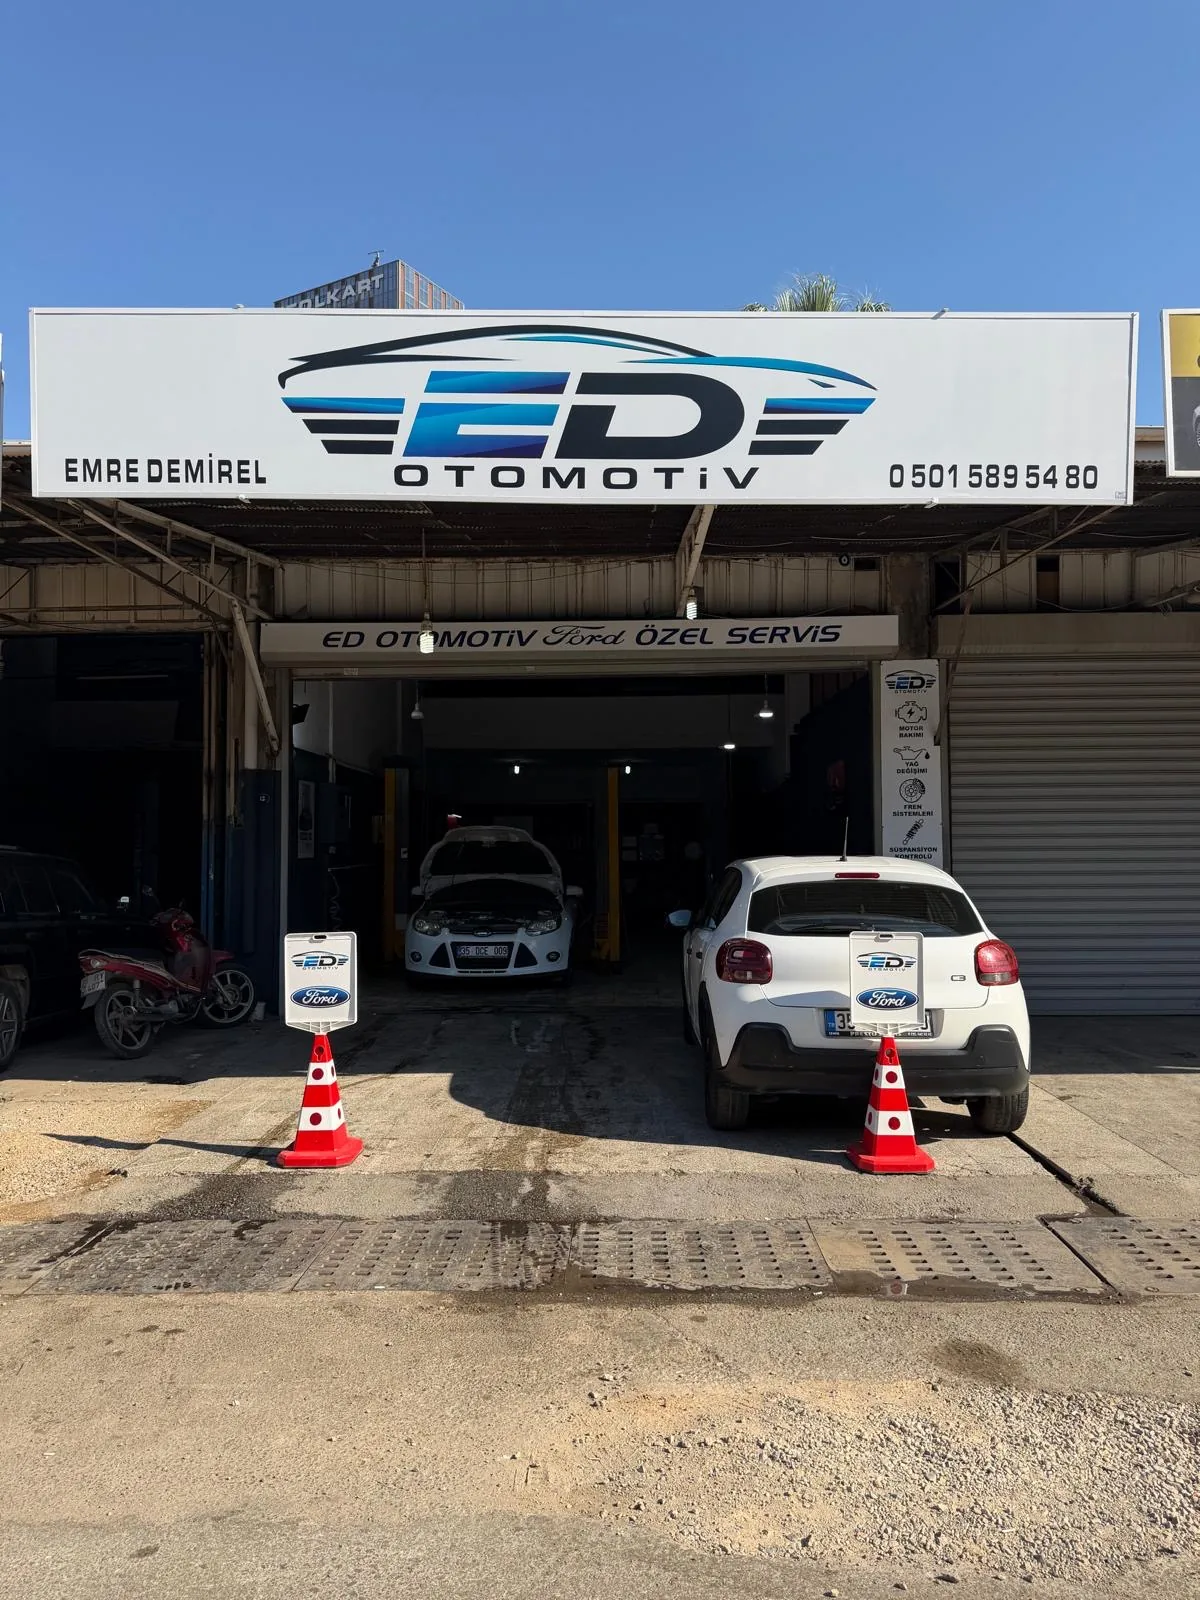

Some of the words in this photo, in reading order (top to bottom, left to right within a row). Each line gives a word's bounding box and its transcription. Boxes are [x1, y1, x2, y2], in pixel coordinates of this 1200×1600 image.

[403, 370, 745, 460] ED
[65, 458, 140, 483] EMRE
[147, 452, 267, 485] DEMİREL
[889, 463, 905, 488] 0
[911, 464, 959, 488] 501
[968, 464, 1018, 489] 589
[1025, 465, 1058, 489] 54
[1065, 465, 1098, 490] 80
[322, 631, 365, 648] ED
[542, 625, 627, 646] Ford
[635, 624, 716, 646] ÖZEL
[896, 677, 925, 689] ED
[461, 946, 470, 955] 35
[303, 955, 337, 967] ED
[869, 957, 904, 968] ED
